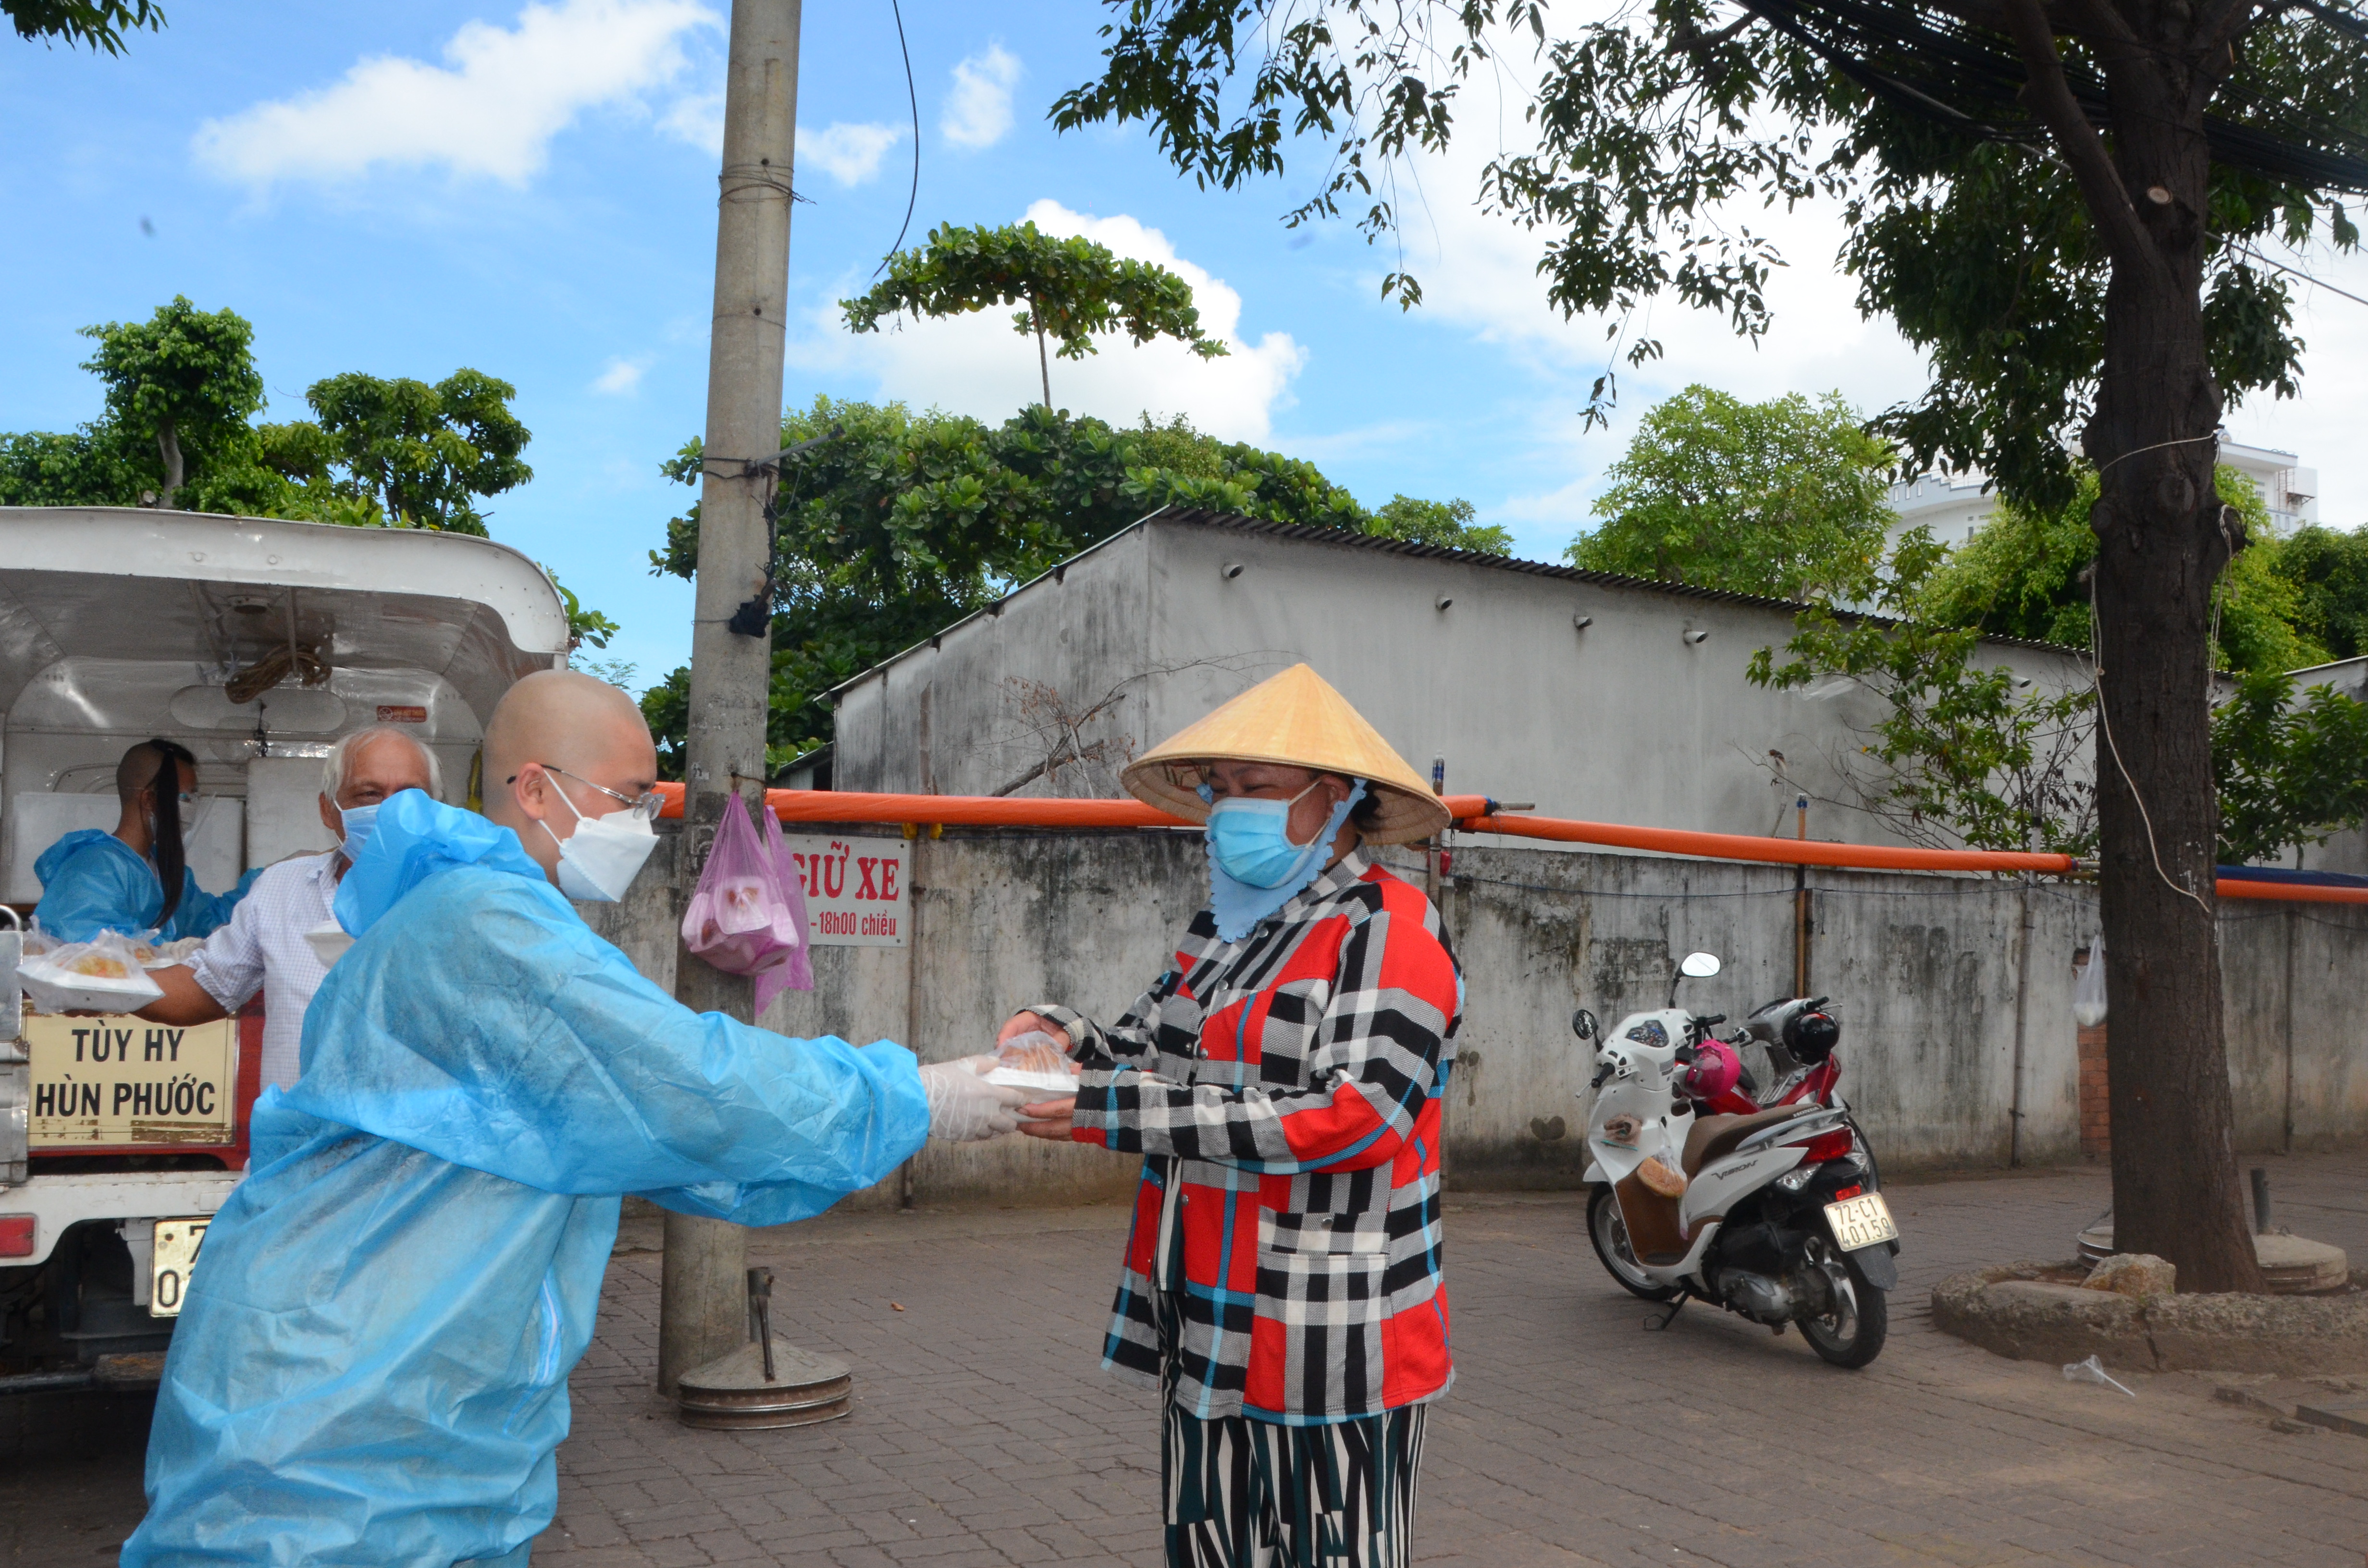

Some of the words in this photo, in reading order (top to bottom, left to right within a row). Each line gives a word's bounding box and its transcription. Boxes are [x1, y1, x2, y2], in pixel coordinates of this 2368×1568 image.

[855, 857, 900, 901] XE
[861, 909, 897, 936] chiều
[72, 1019, 134, 1062] TÙY
[144, 1029, 185, 1062] HY
[35, 1073, 101, 1117] HÙN
[113, 1073, 215, 1115] PHƯỚC
[1792, 1106, 1820, 1118] HONDA
